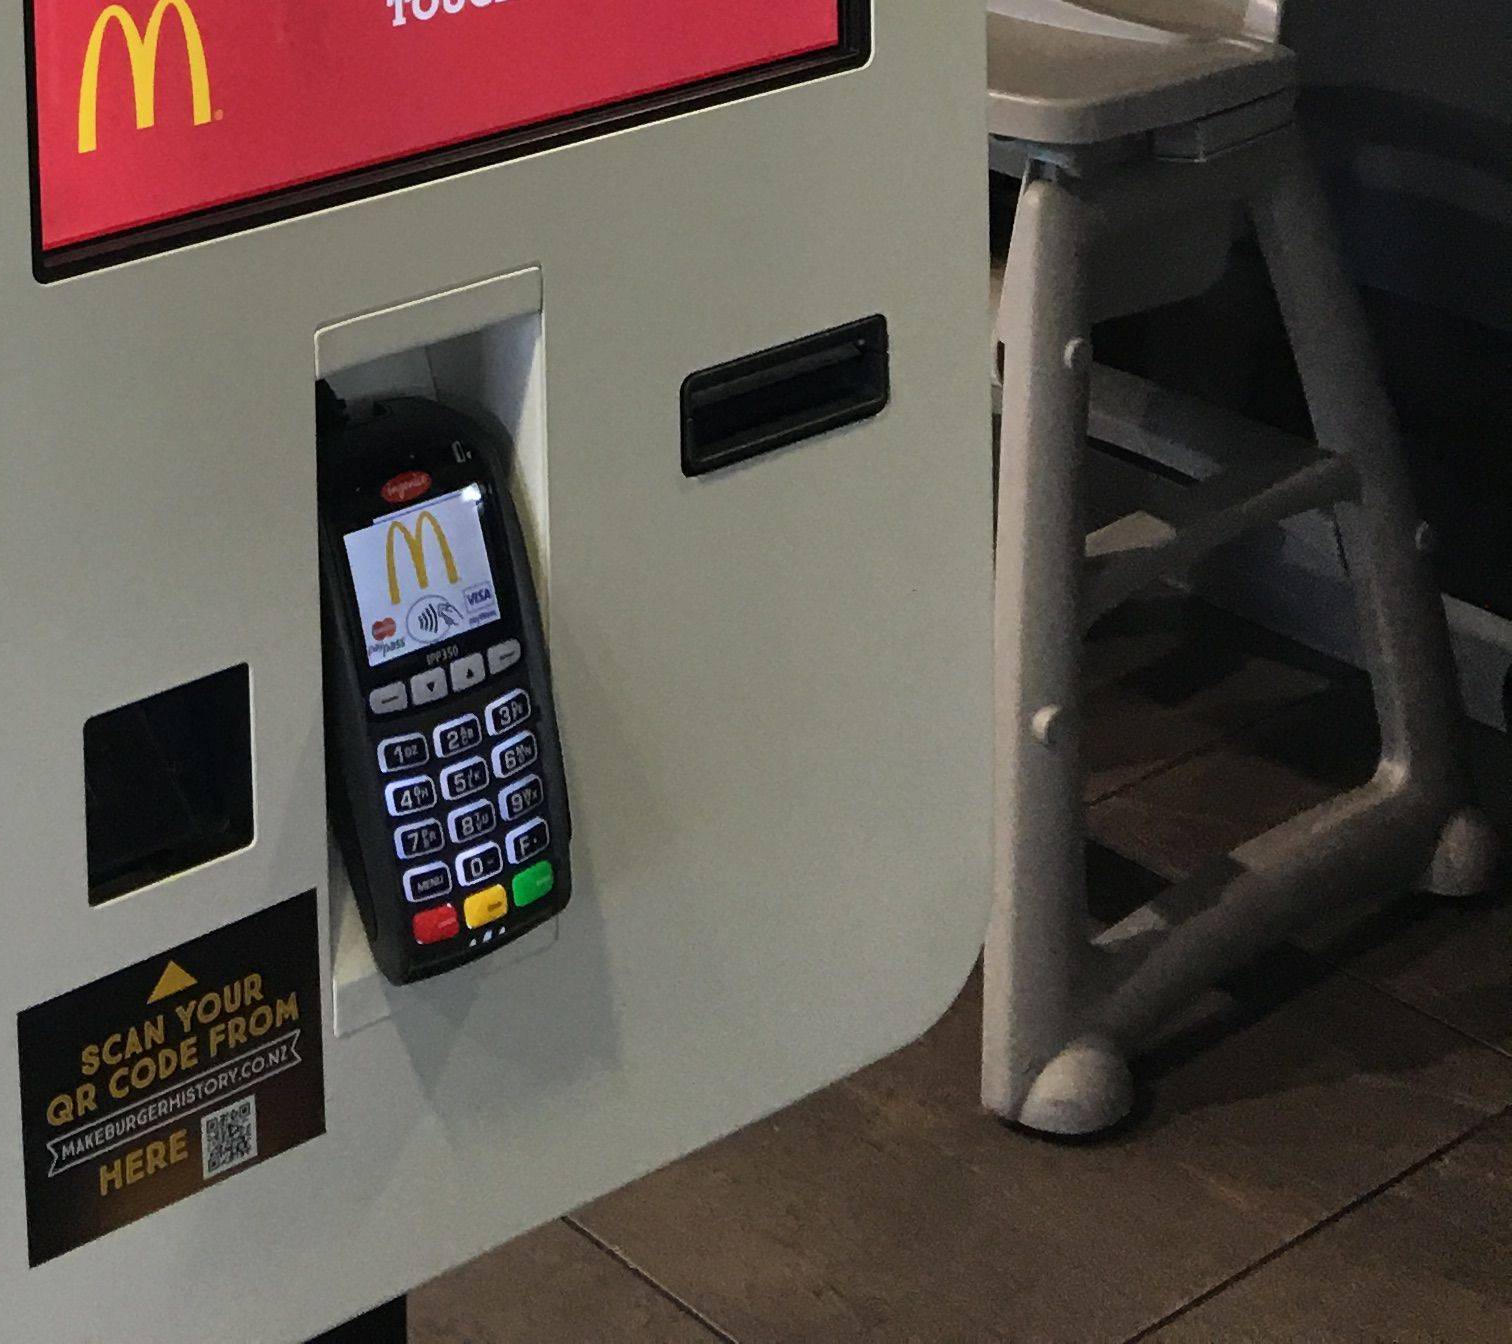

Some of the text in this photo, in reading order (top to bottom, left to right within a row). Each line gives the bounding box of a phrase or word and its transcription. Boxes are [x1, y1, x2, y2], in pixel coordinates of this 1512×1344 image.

[46, 991, 300, 1127] QR CODE FROM
[81, 972, 263, 1076] SCAN YOUR
[61, 1044, 288, 1162] MAKEBURGERHISTORY.CO.NZ
[99, 1128, 189, 1197] HERE
